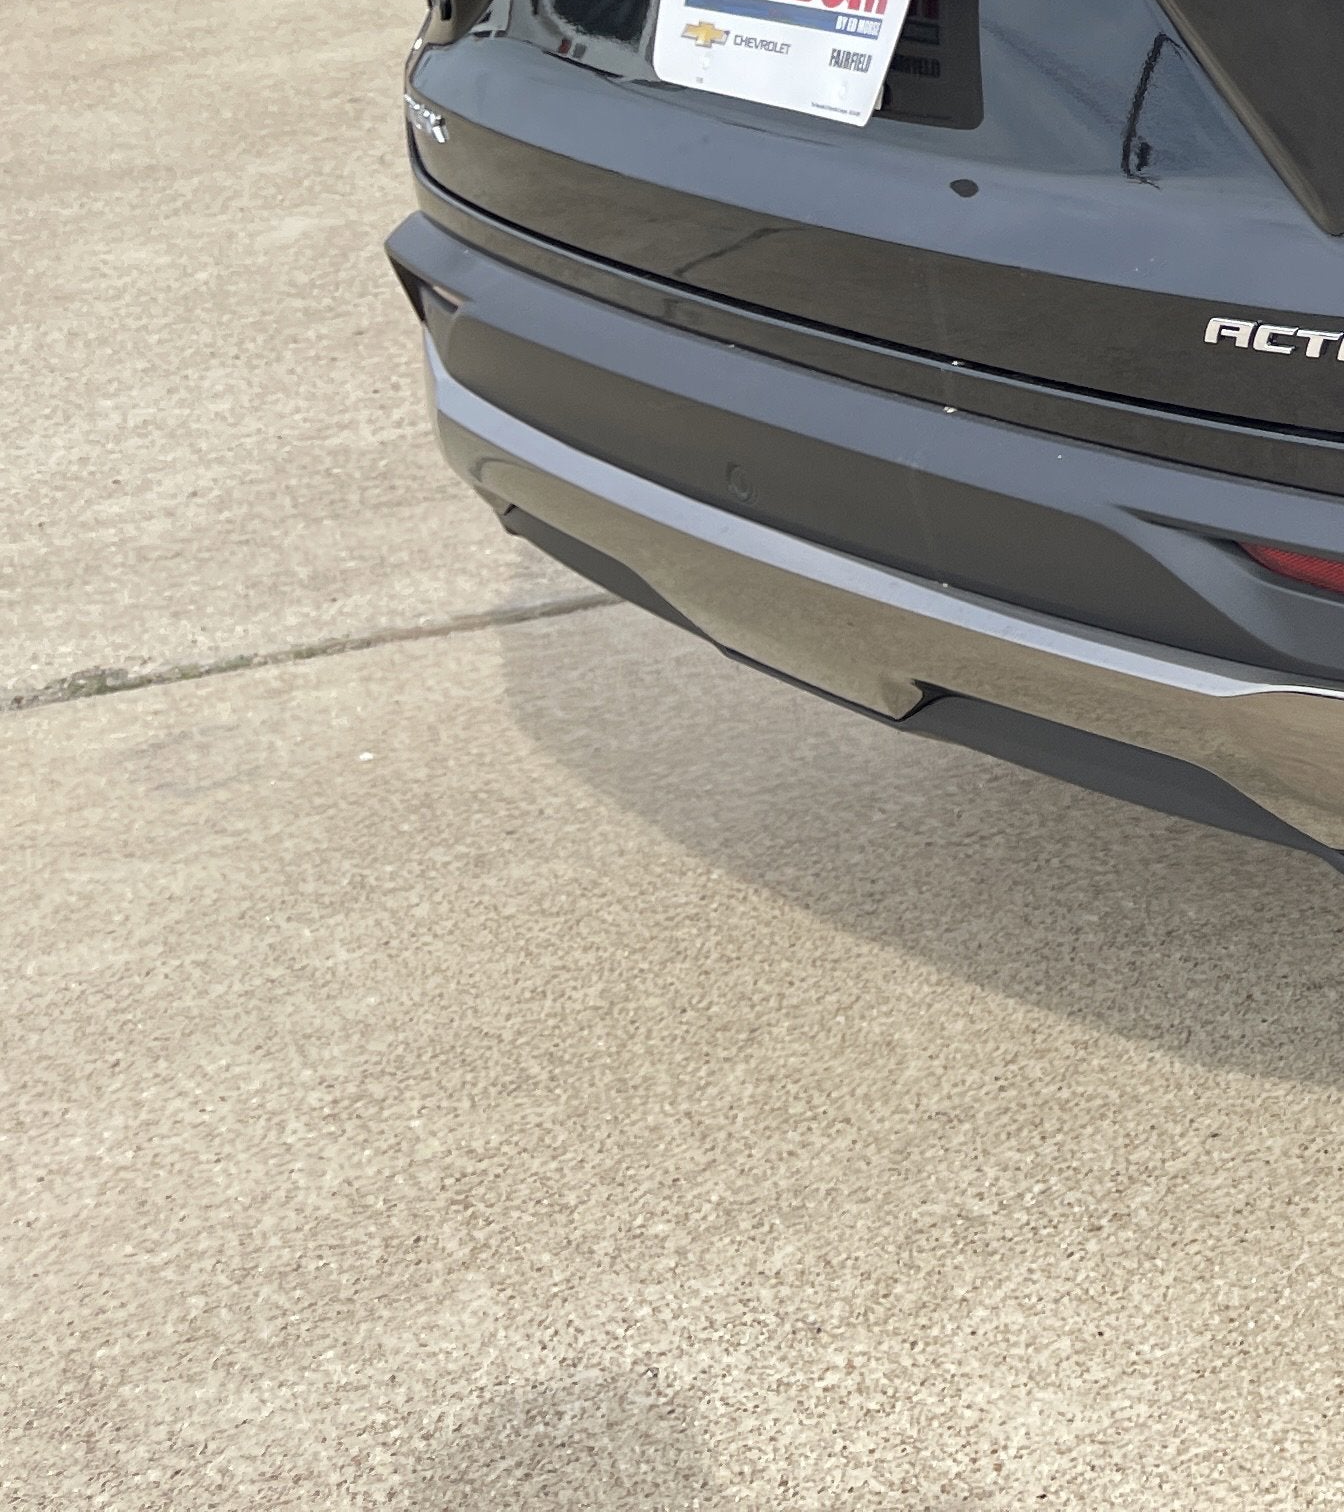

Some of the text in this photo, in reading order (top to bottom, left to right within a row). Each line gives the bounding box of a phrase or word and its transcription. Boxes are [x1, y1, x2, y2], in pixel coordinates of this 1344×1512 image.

[835, 15, 848, 30] BY
[847, 18, 858, 32] ED
[733, 33, 791, 56] CHEVROLET
[828, 47, 873, 74] FAIRFIELD
